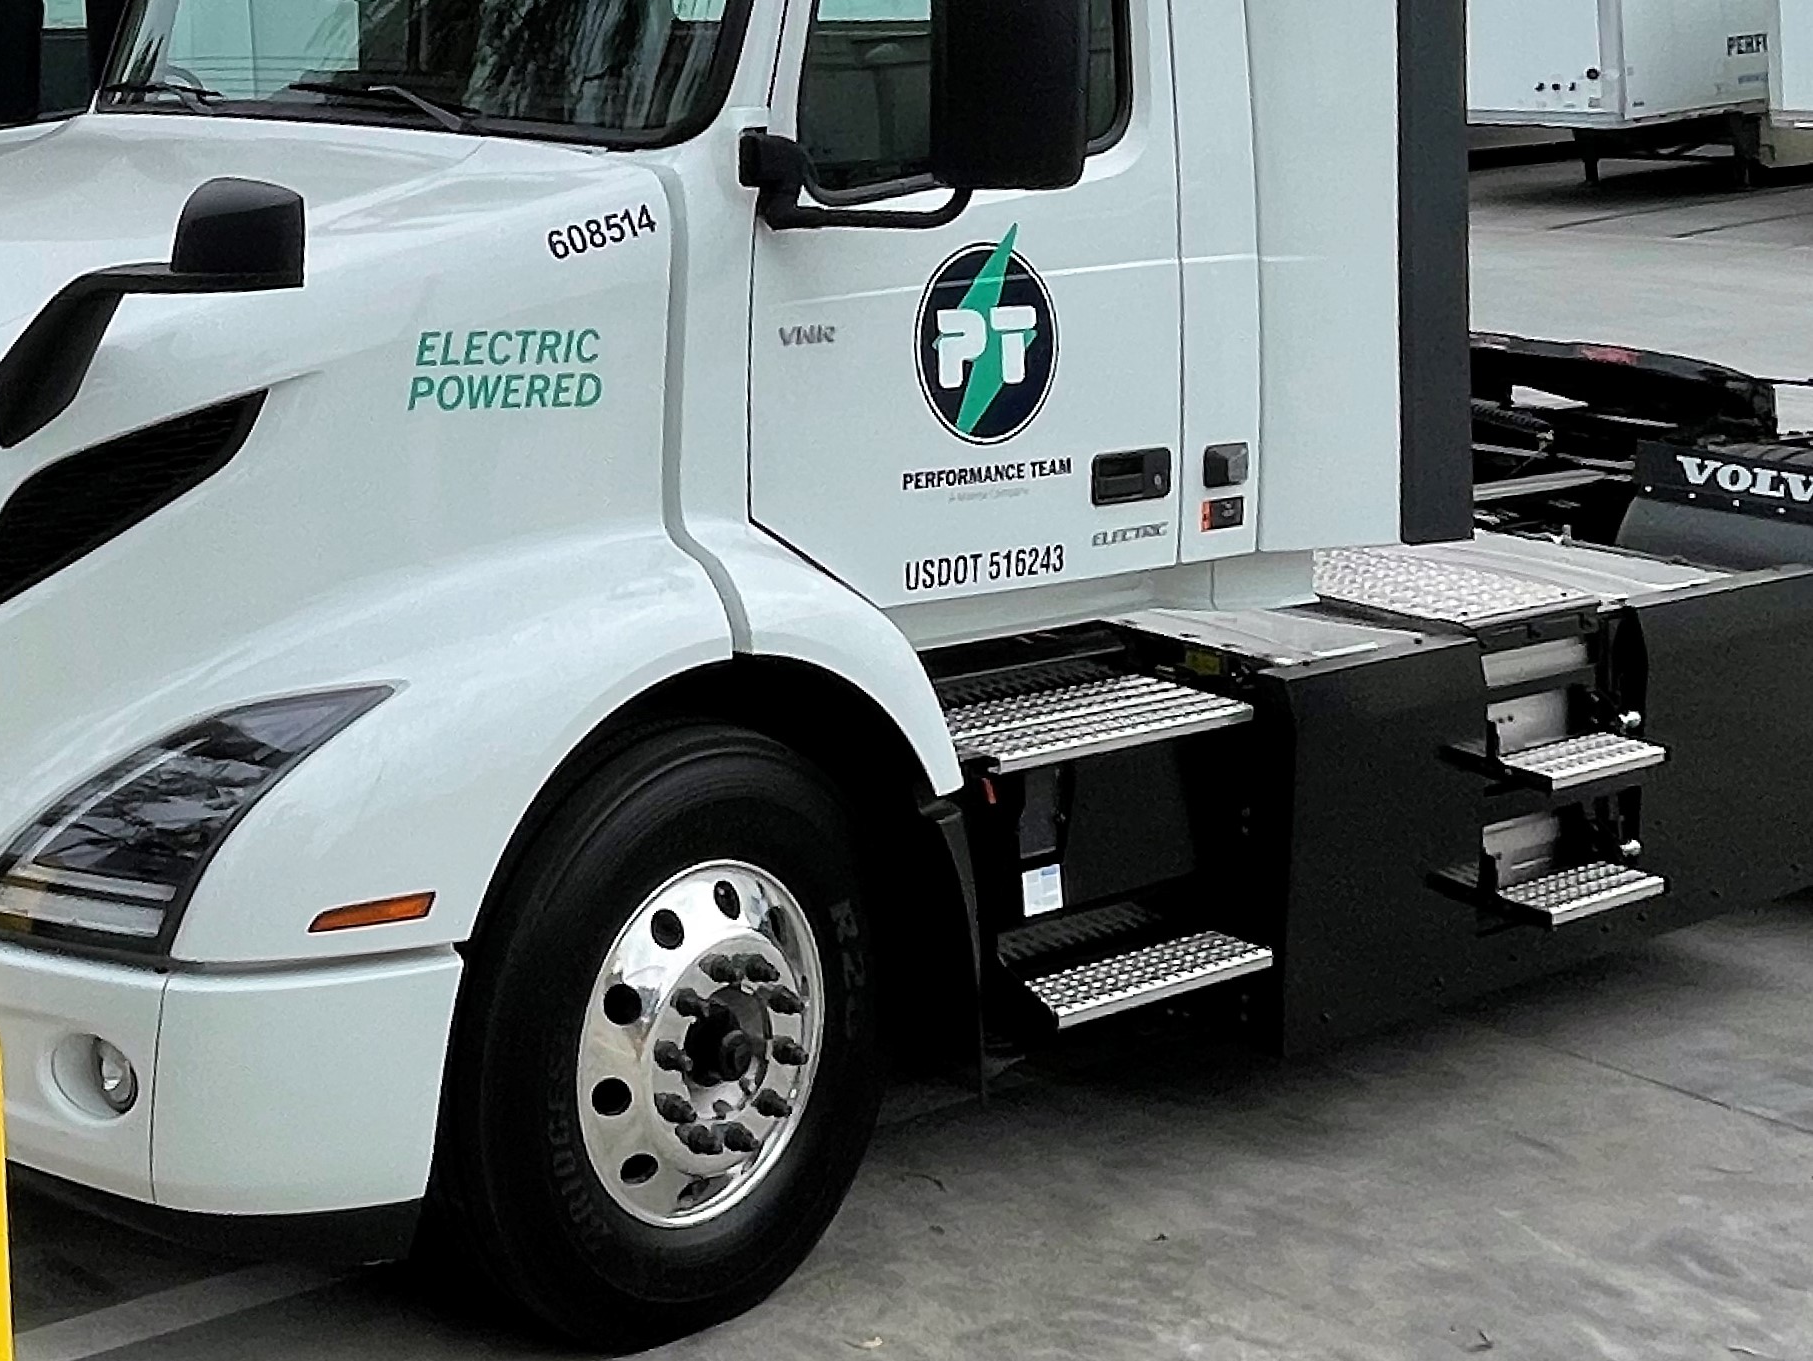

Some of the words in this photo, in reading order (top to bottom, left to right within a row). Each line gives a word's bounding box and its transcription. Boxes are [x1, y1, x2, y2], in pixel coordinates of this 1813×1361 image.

[547, 204, 658, 259] 608514
[415, 328, 601, 366] ELECTRIC
[407, 372, 603, 411] POWERED
[902, 463, 1025, 490] PERFORMANCE
[1030, 457, 1073, 479] TEAM
[905, 553, 983, 591] USDOT
[988, 544, 1064, 580] 516243
